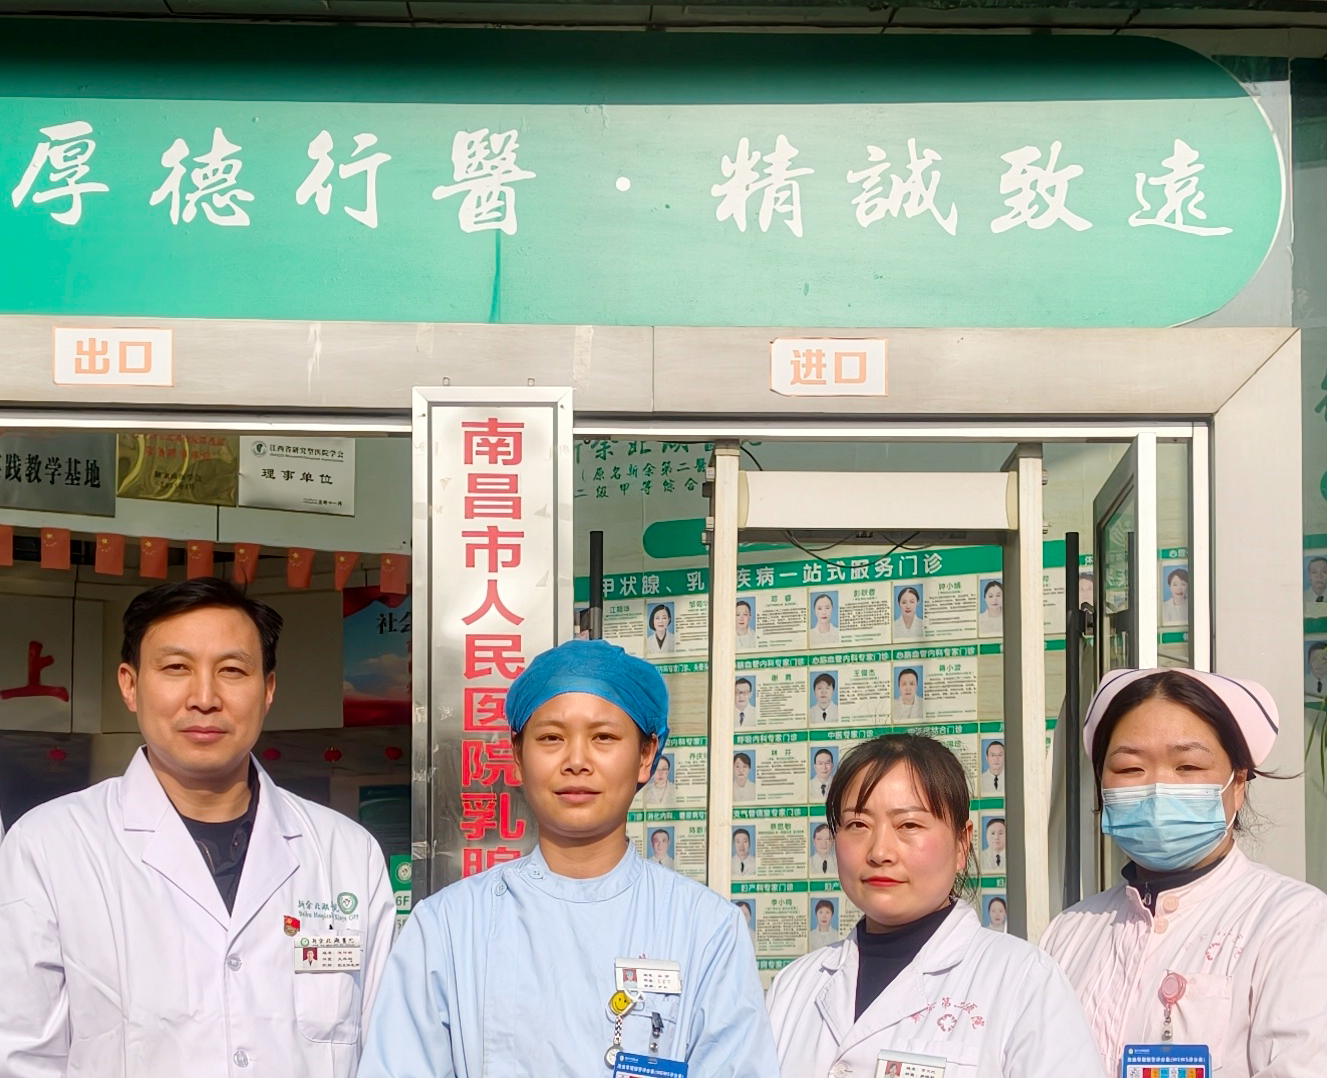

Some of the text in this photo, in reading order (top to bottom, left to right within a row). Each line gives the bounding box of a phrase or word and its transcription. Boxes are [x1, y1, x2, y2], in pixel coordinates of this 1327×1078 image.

[75, 336, 153, 374] 出口
[790, 350, 869, 387] 进口
[261, 468, 334, 486] 理事单位
[736, 658, 805, 670] 脑血管内科专家门诊
[395, 895, 410, 907] 6F
